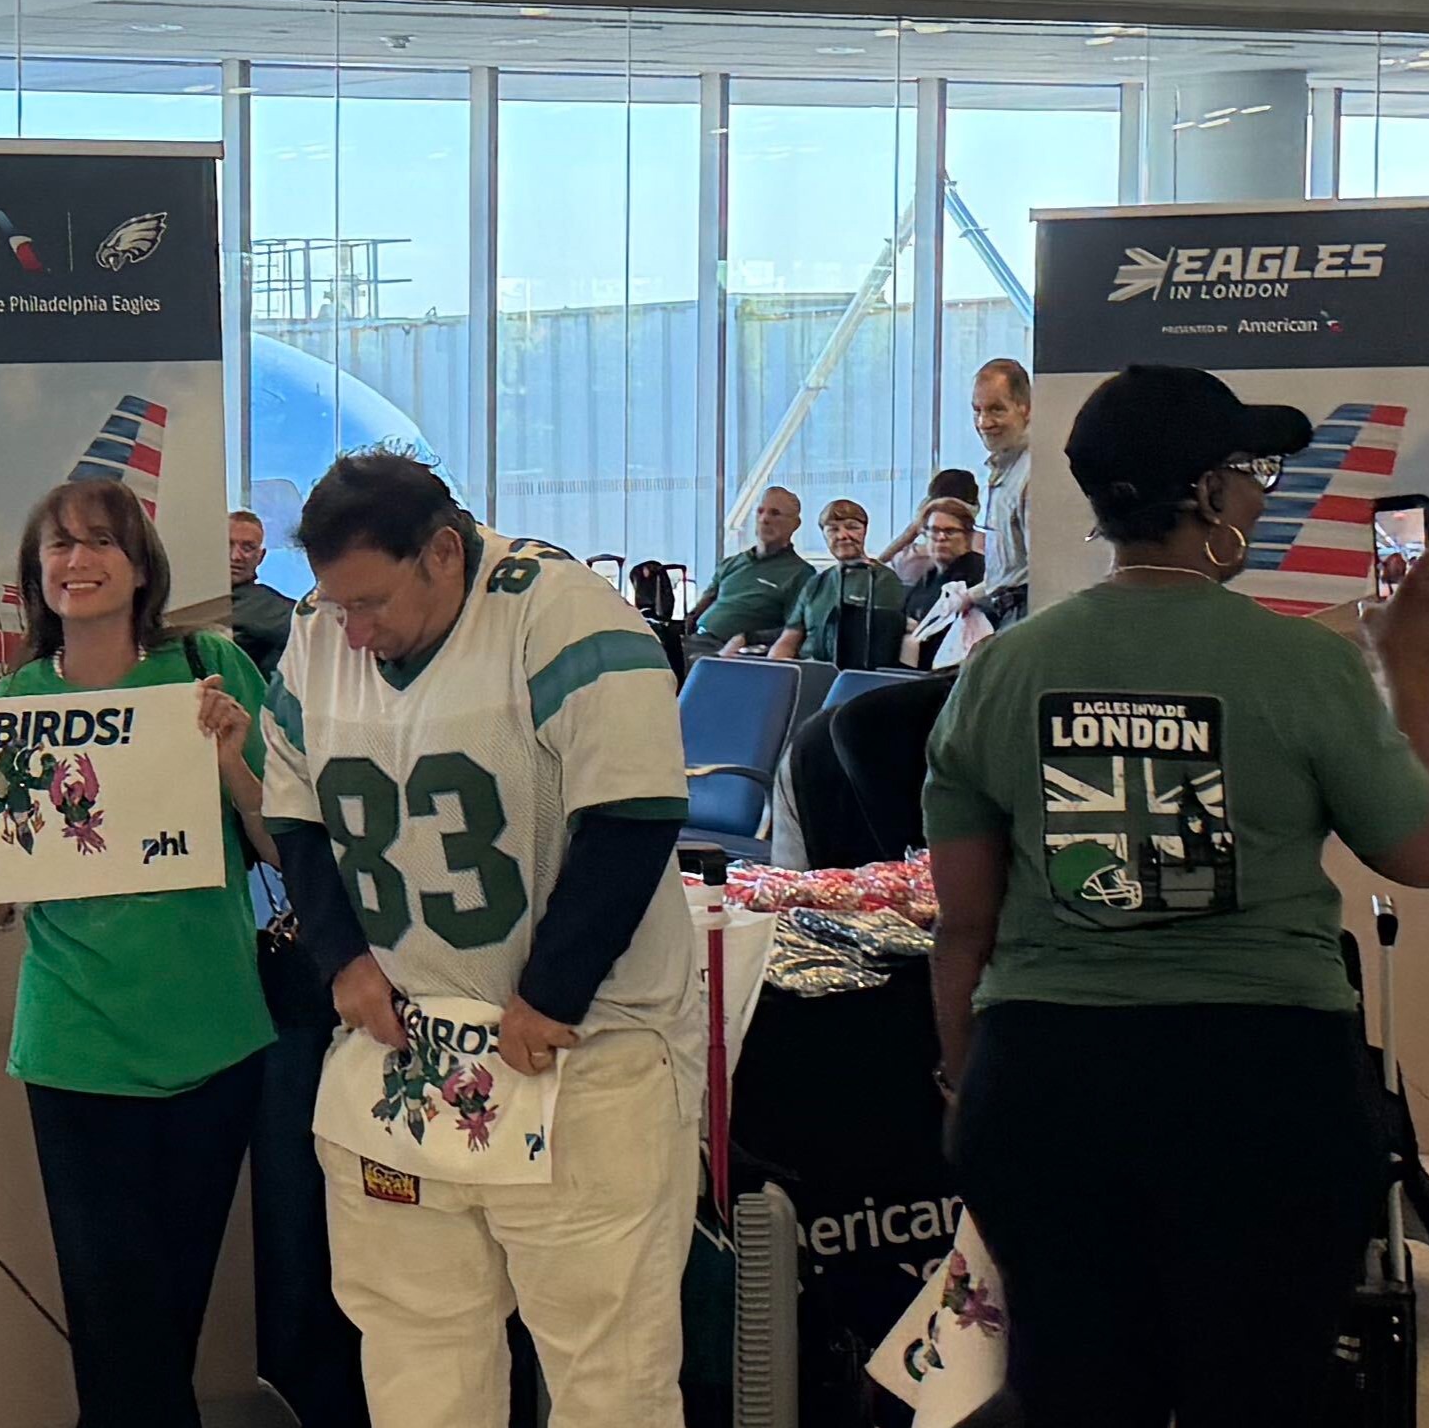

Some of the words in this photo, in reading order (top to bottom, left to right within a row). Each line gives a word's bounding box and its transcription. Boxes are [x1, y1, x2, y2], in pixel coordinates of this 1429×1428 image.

[1172, 243, 1387, 282] EAGLES
[10, 294, 108, 315] Philadelphia
[112, 296, 161, 315] Eagles
[1170, 284, 1192, 300] IN
[1201, 282, 1289, 300] LONDON
[1237, 318, 1318, 334] American
[1073, 701, 1131, 716] EAGLES
[1132, 703, 1187, 718] INVADE
[1051, 716, 1209, 752] LONDON
[142, 830, 189, 865] phl
[316, 752, 529, 952] 83
